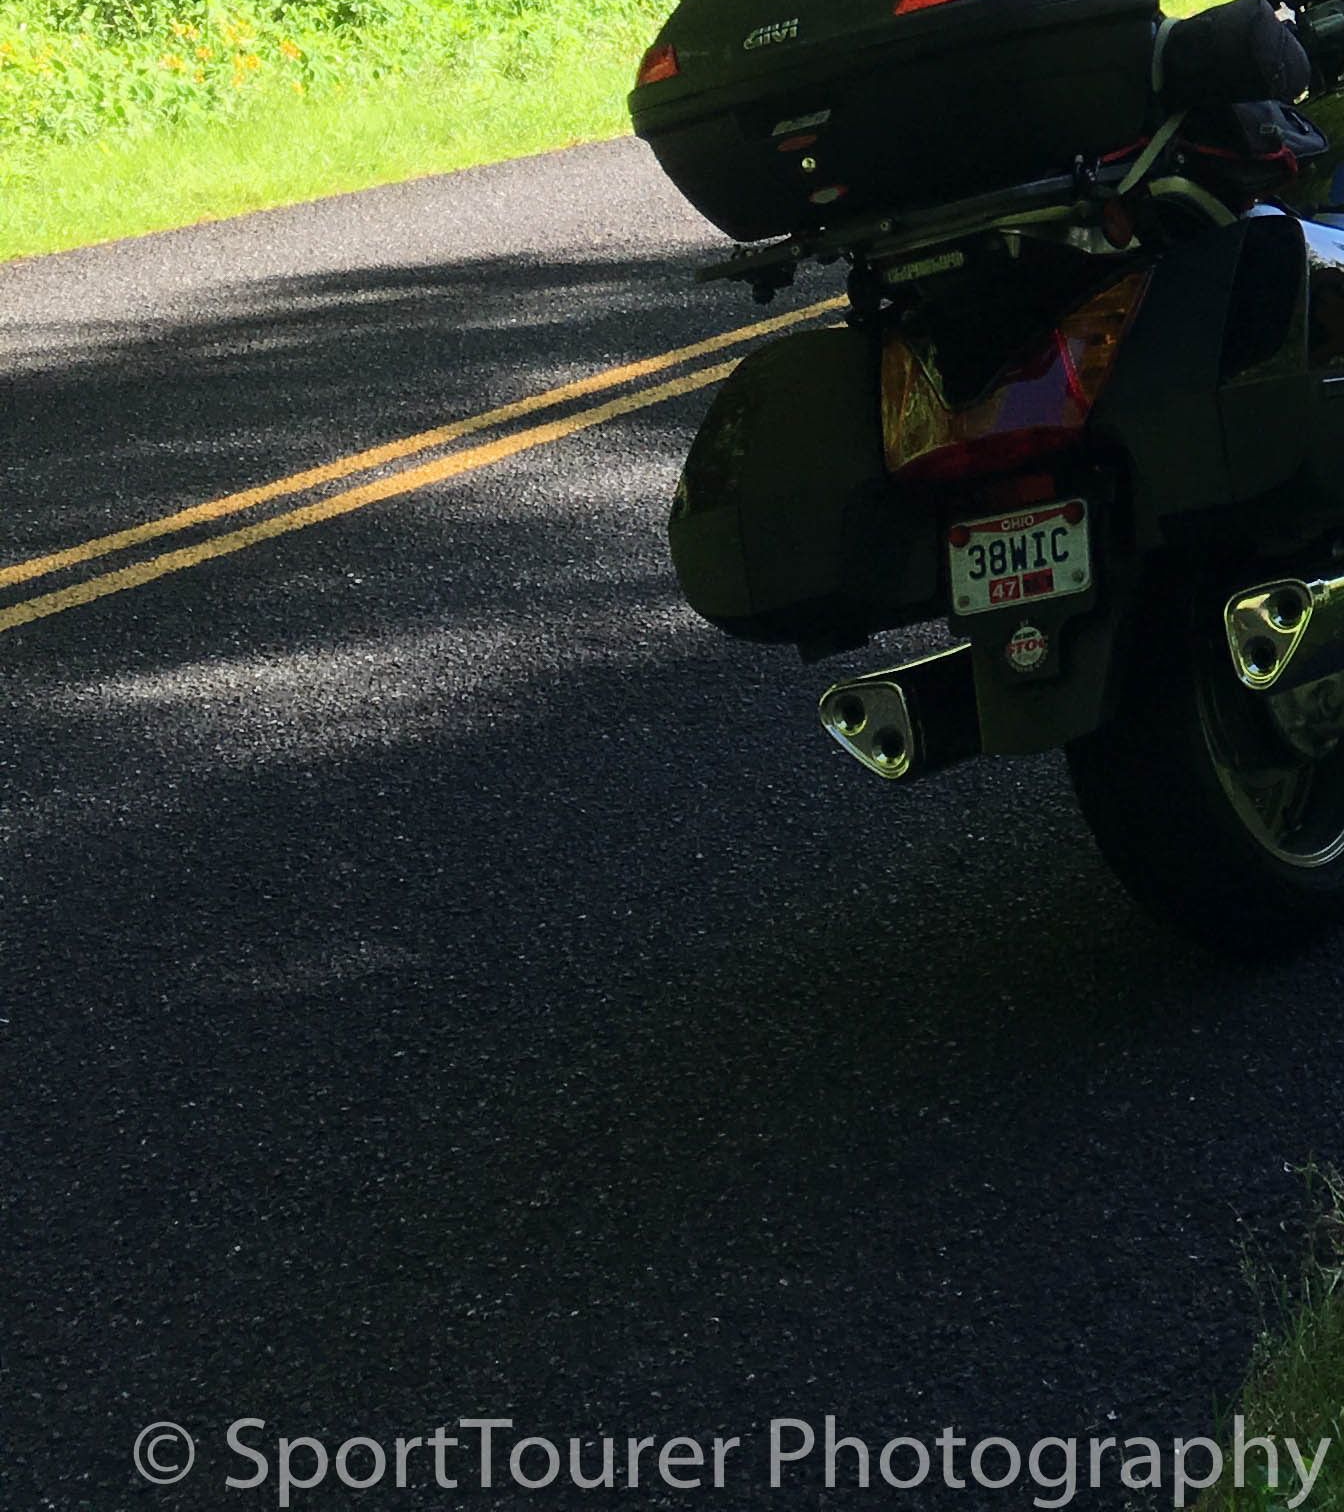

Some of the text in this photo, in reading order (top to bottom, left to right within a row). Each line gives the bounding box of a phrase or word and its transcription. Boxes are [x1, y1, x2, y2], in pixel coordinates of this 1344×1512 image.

[1000, 515, 1034, 531] OHIO
[968, 527, 1069, 579] 38WIC
[991, 582, 1017, 600] 47
